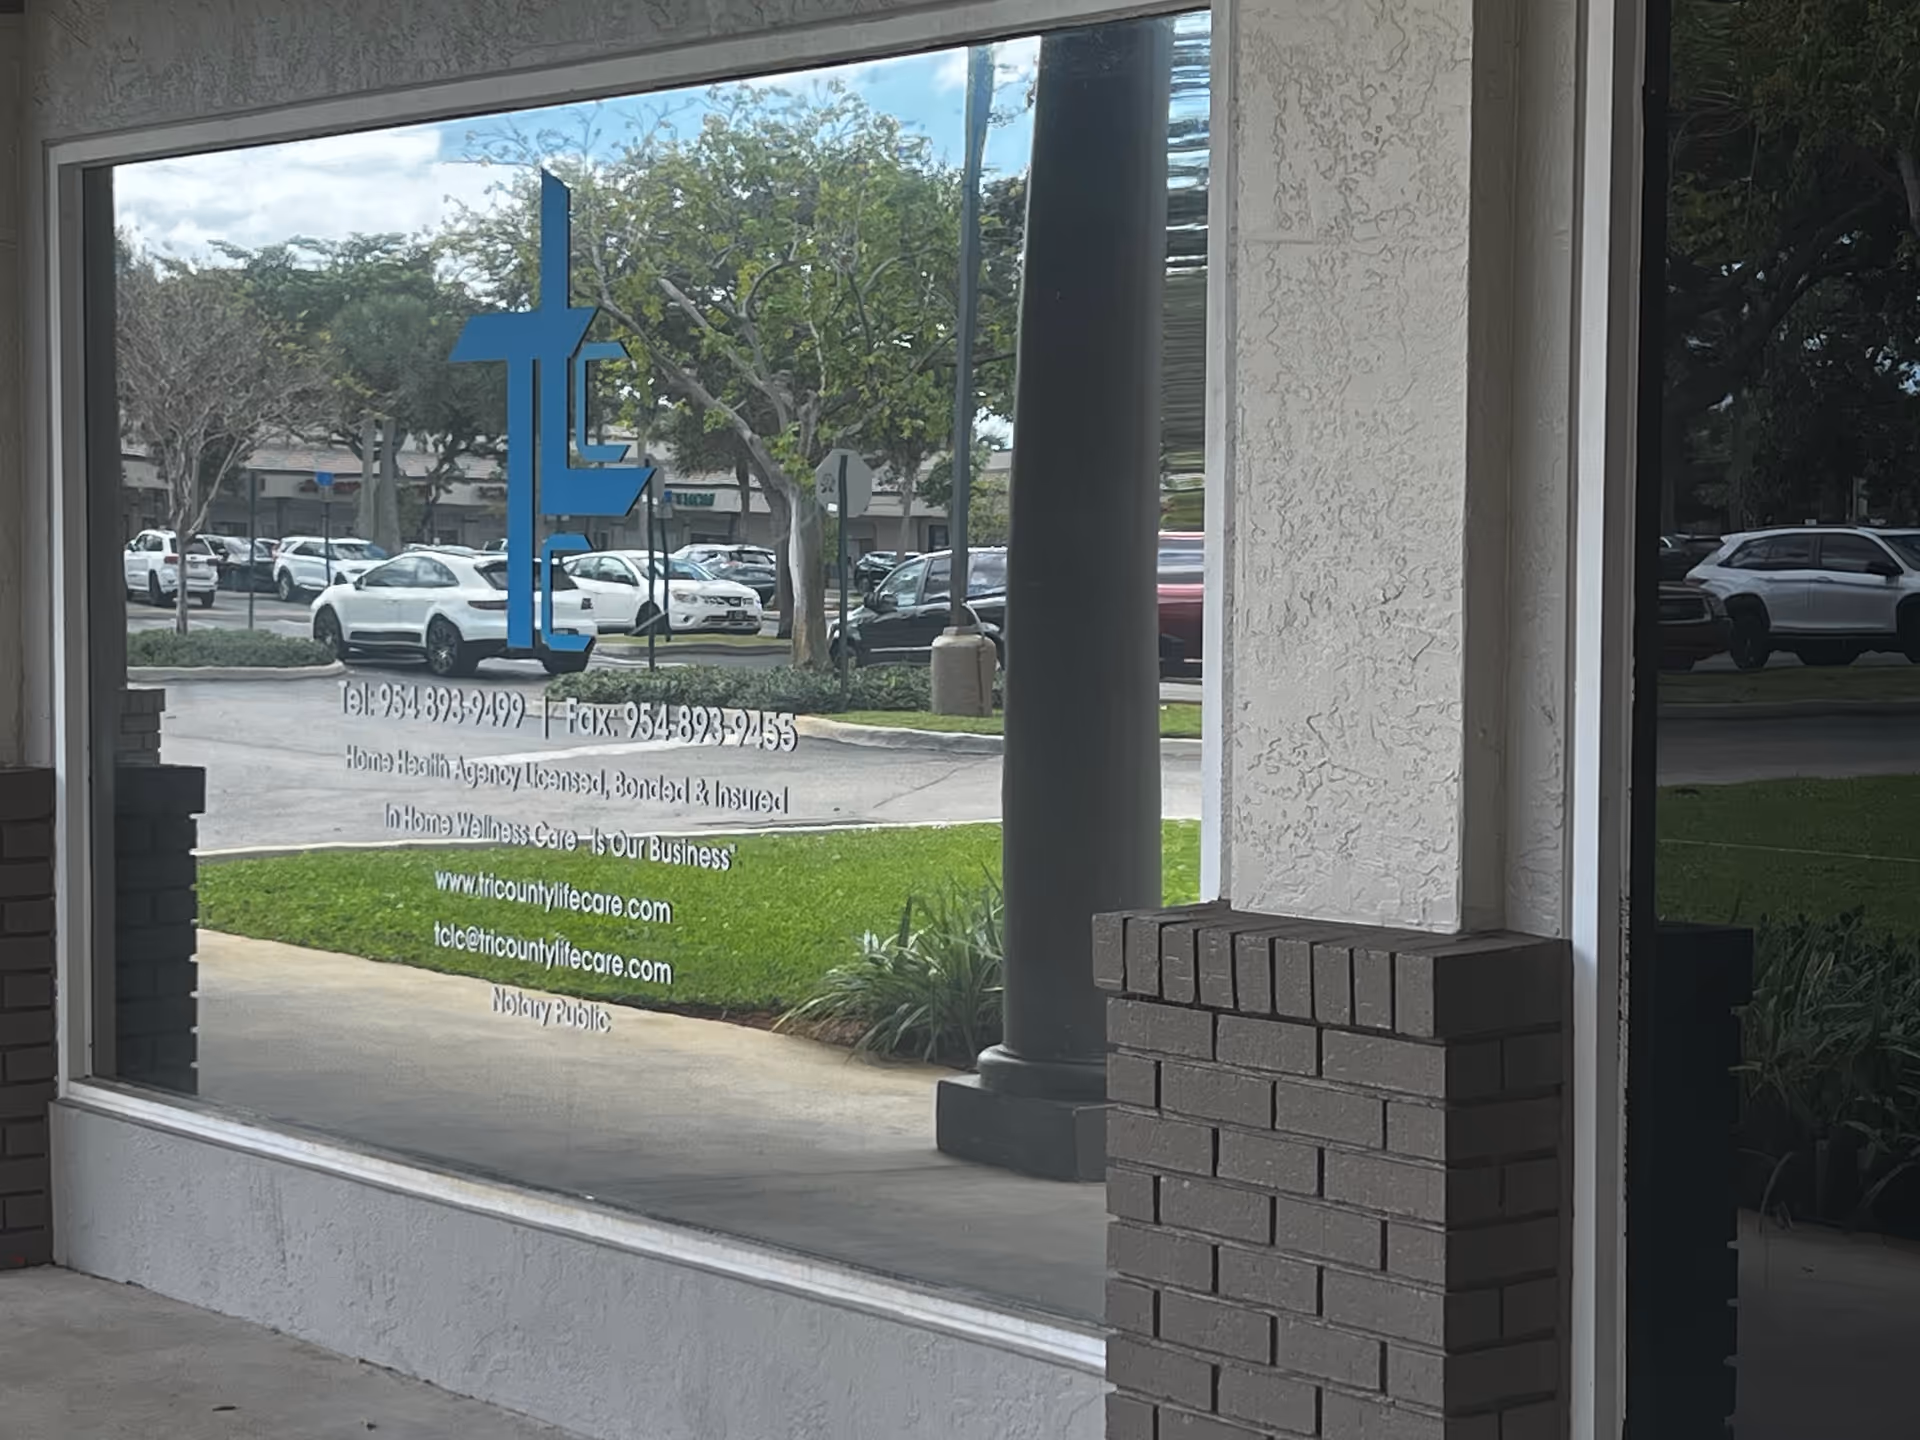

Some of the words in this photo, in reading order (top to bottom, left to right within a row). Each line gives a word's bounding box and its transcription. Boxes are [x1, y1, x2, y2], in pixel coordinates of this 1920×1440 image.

[338, 681, 375, 716] Tel:
[566, 697, 618, 737] Fax:
[624, 700, 798, 752] 954-893-9455
[346, 744, 393, 773] Home
[397, 749, 449, 779] Health
[454, 755, 521, 792] Agency
[526, 761, 610, 799] Licensed,
[615, 770, 690, 804] Bonded
[694, 776, 710, 806] &
[715, 780, 789, 814] Insured
[404, 805, 451, 836] Home
[457, 811, 530, 846] Wellness
[534, 820, 578, 852] Care
[592, 827, 607, 857] Is
[610, 830, 645, 860] Our
[434, 869, 673, 924] www.tricountylifecare.com
[434, 920, 673, 985] tclc@tricountylifecare.com
[491, 986, 552, 1027] Notary
[555, 999, 612, 1034] Public
